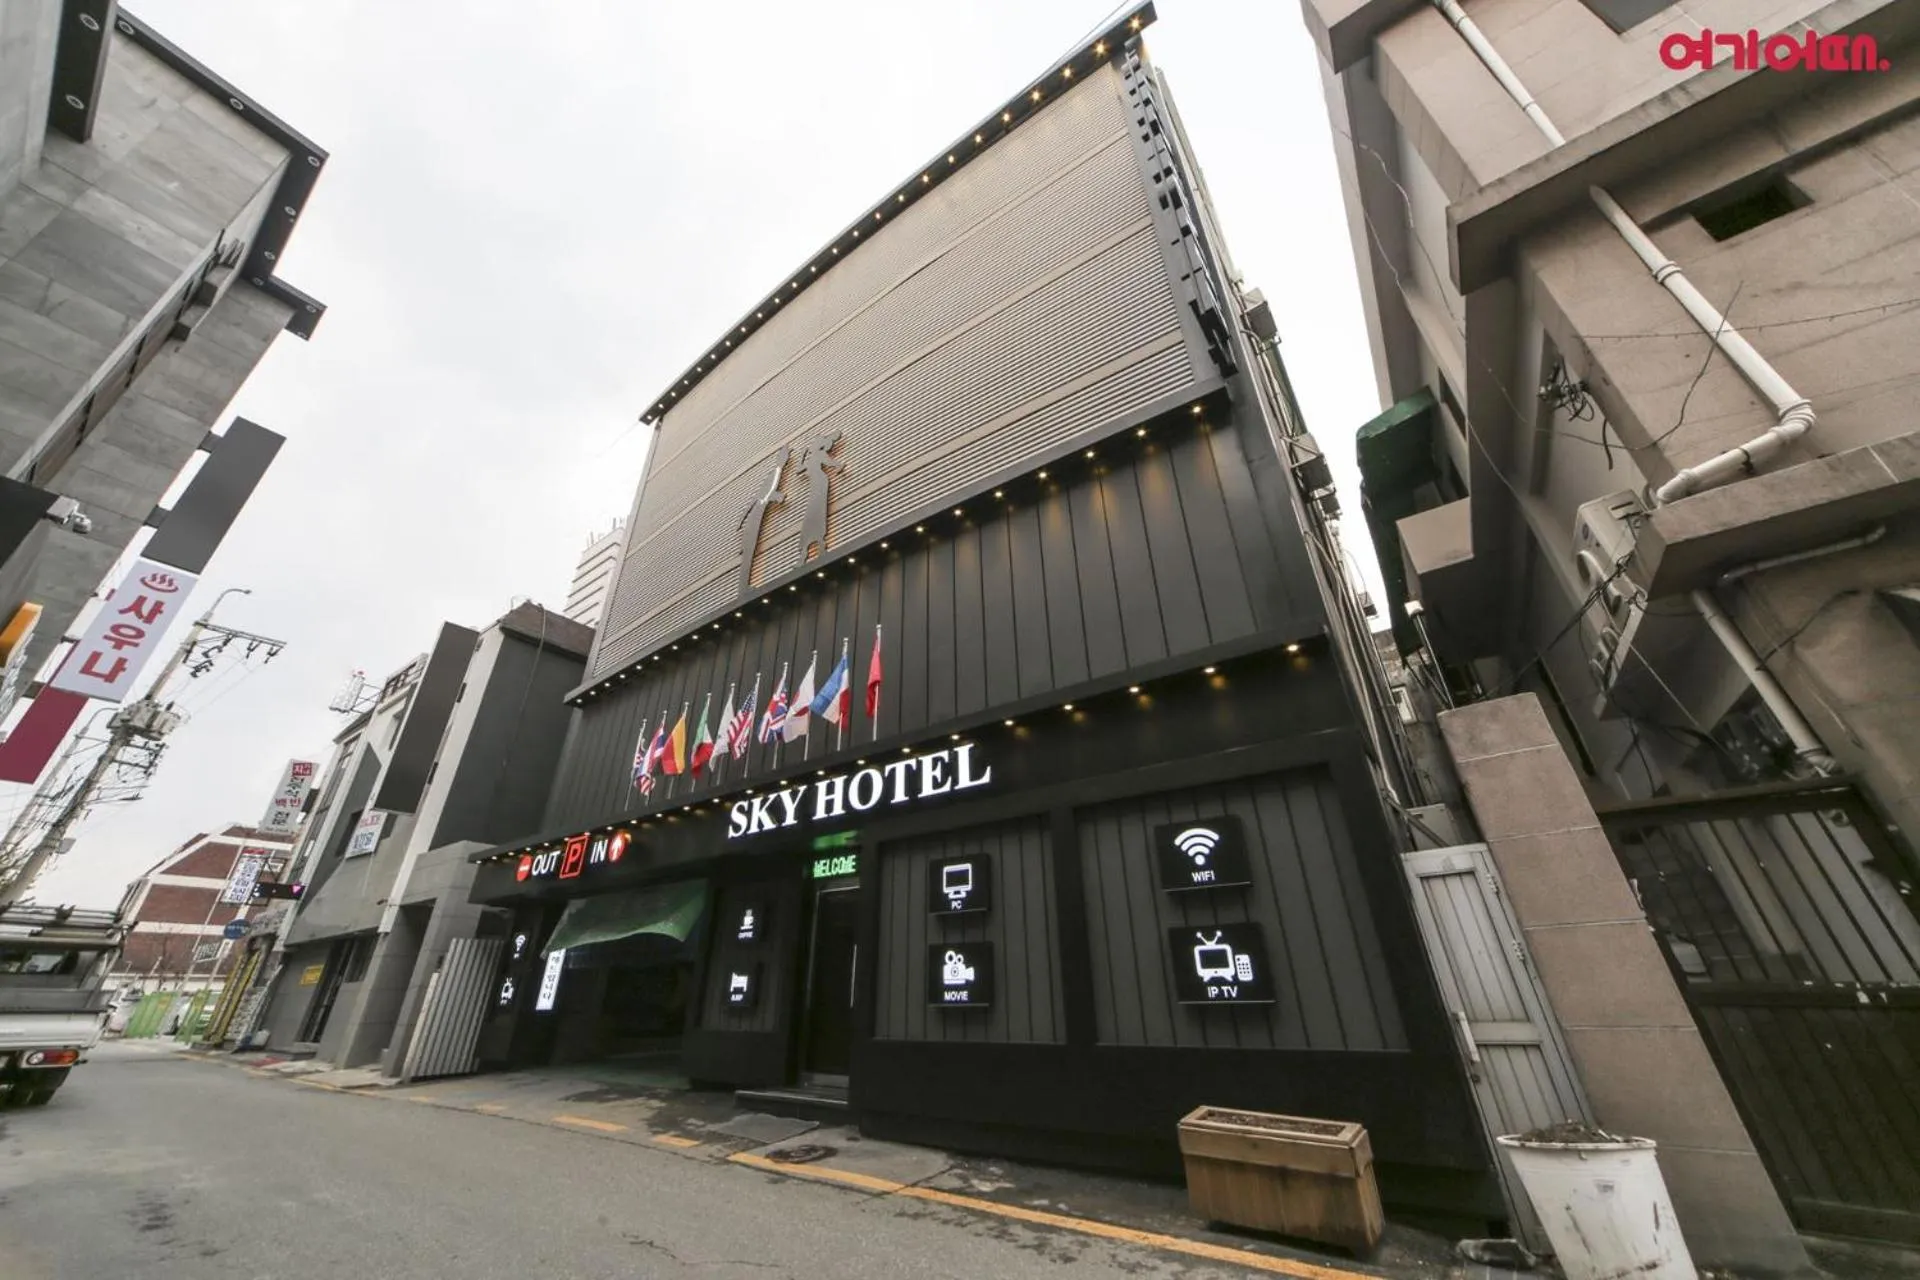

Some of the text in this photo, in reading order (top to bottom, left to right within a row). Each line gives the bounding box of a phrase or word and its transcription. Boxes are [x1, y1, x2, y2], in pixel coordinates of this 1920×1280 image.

[79, 594, 165, 684] 사우나
[727, 743, 991, 839] SKY HOTEL
[531, 839, 608, 876] OUT P IN
[813, 854, 857, 878] WELCOME
[1191, 870, 1215, 882] WIFI
[951, 900, 962, 910] PC
[943, 991, 969, 1001] MOVIE
[1207, 986, 1238, 998] IP TV
